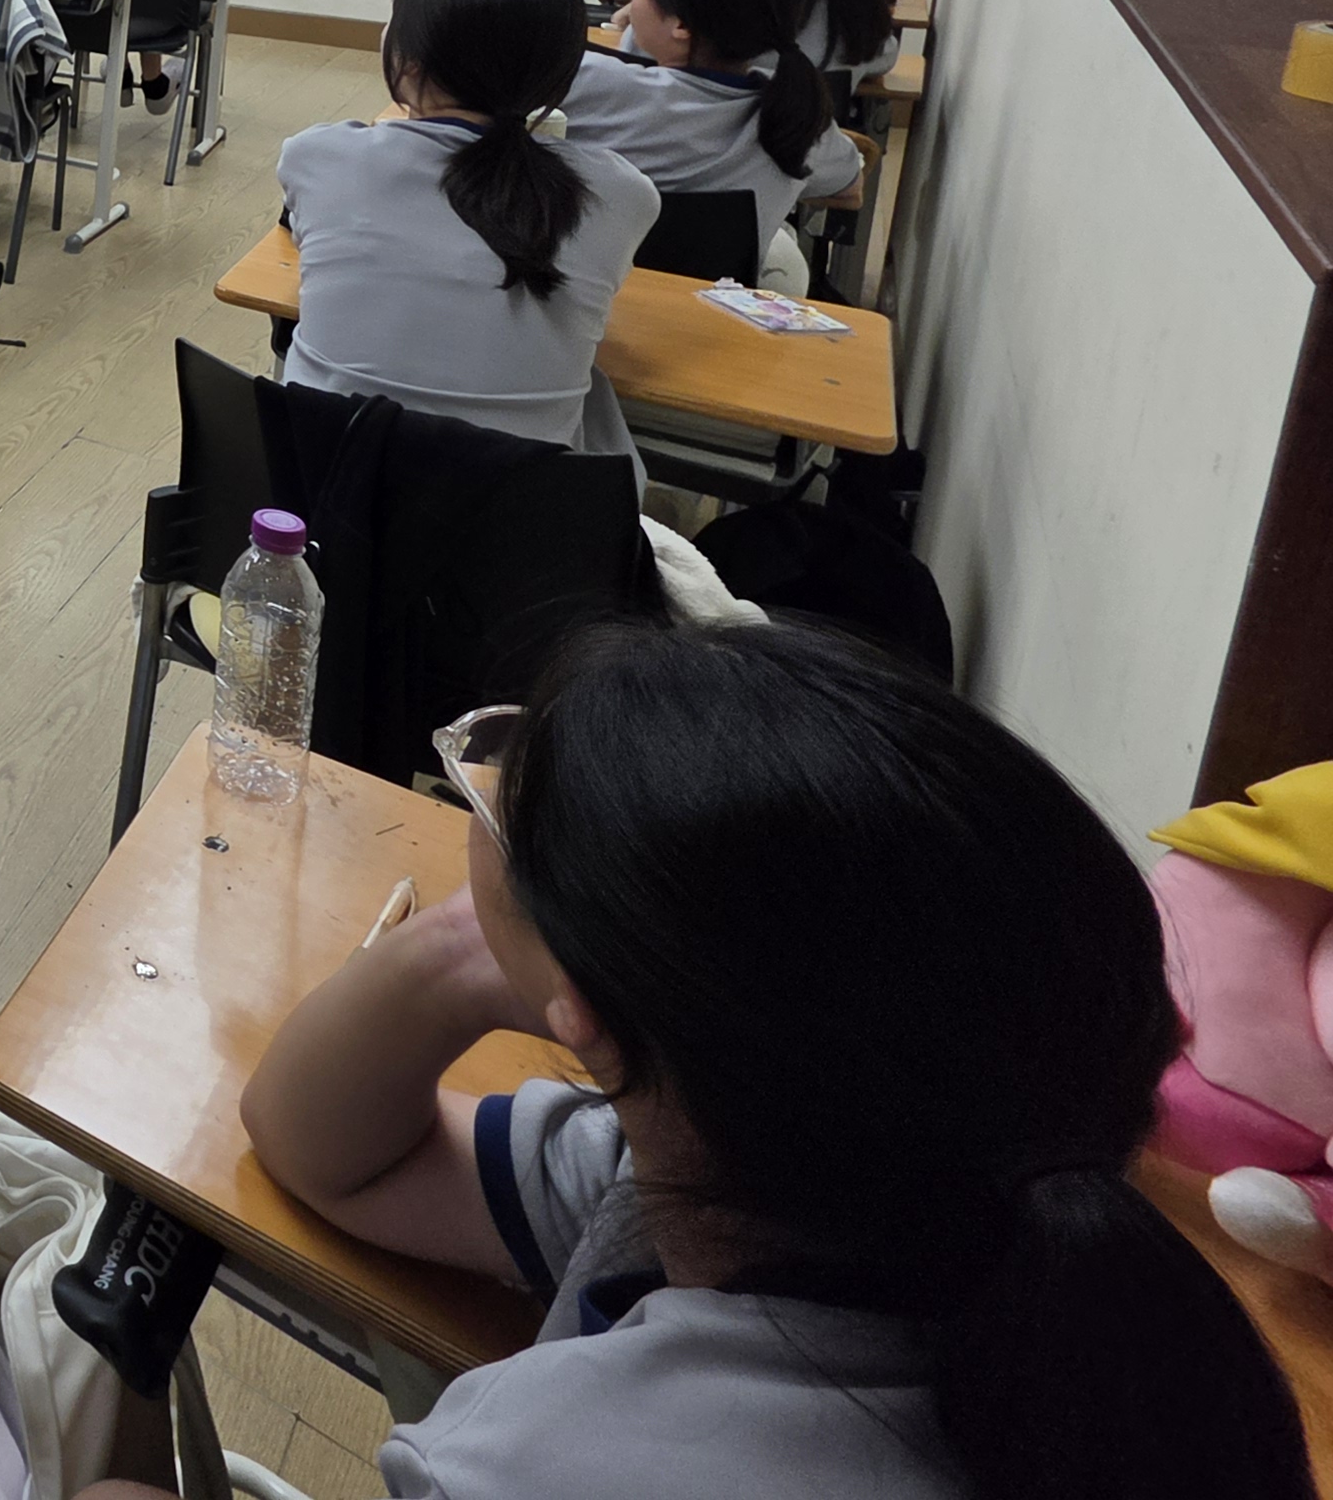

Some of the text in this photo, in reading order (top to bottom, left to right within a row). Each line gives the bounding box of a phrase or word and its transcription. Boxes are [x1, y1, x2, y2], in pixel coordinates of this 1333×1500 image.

[93, 1194, 146, 1290] OUNG CHANG
[124, 1210, 184, 1308] HDC
